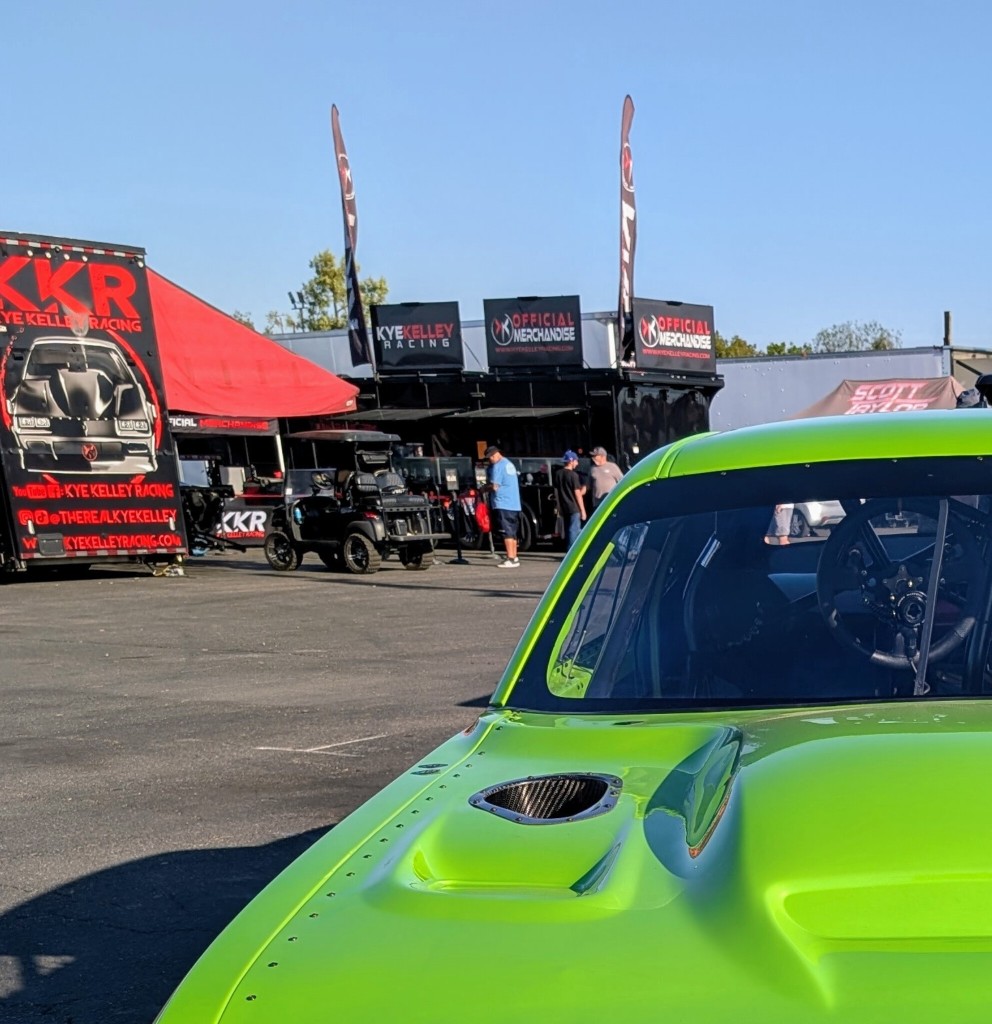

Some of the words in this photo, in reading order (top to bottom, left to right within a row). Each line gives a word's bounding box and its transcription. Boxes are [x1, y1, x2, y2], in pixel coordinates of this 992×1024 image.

[0, 255, 141, 319] KKR
[0, 311, 25, 325] YE
[89, 317, 142, 332] RACING
[512, 312, 575, 328] OFFICIAL
[658, 315, 711, 335] OFFICIAL
[384, 338, 450, 349] RACING
[513, 327, 576, 343] MERCHANDISE
[659, 331, 712, 350] MERCHANDISE
[851, 382, 929, 401] SCOTT
[91, 484, 132, 498] KELLEY
[135, 484, 174, 498] RACING
